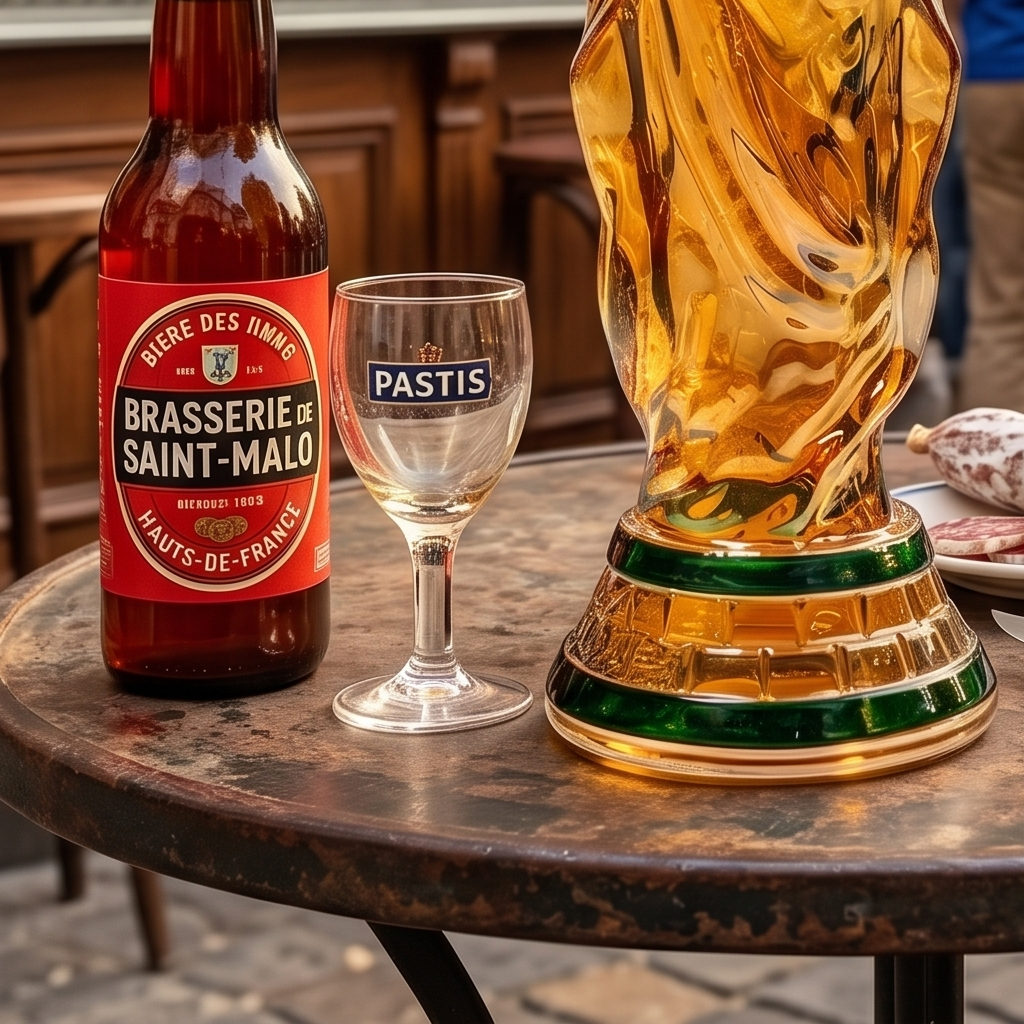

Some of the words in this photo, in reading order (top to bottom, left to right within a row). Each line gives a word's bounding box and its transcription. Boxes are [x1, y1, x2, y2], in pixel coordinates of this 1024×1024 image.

[199, 312, 240, 332] DES
[375, 368, 486, 397] PASTIS
[124, 394, 292, 435] BRASSERIE
[297, 401, 313, 426] DE
[123, 431, 313, 479] SAINT-MALO
[138, 501, 301, 572] HAUTS-DE-FRANCE
